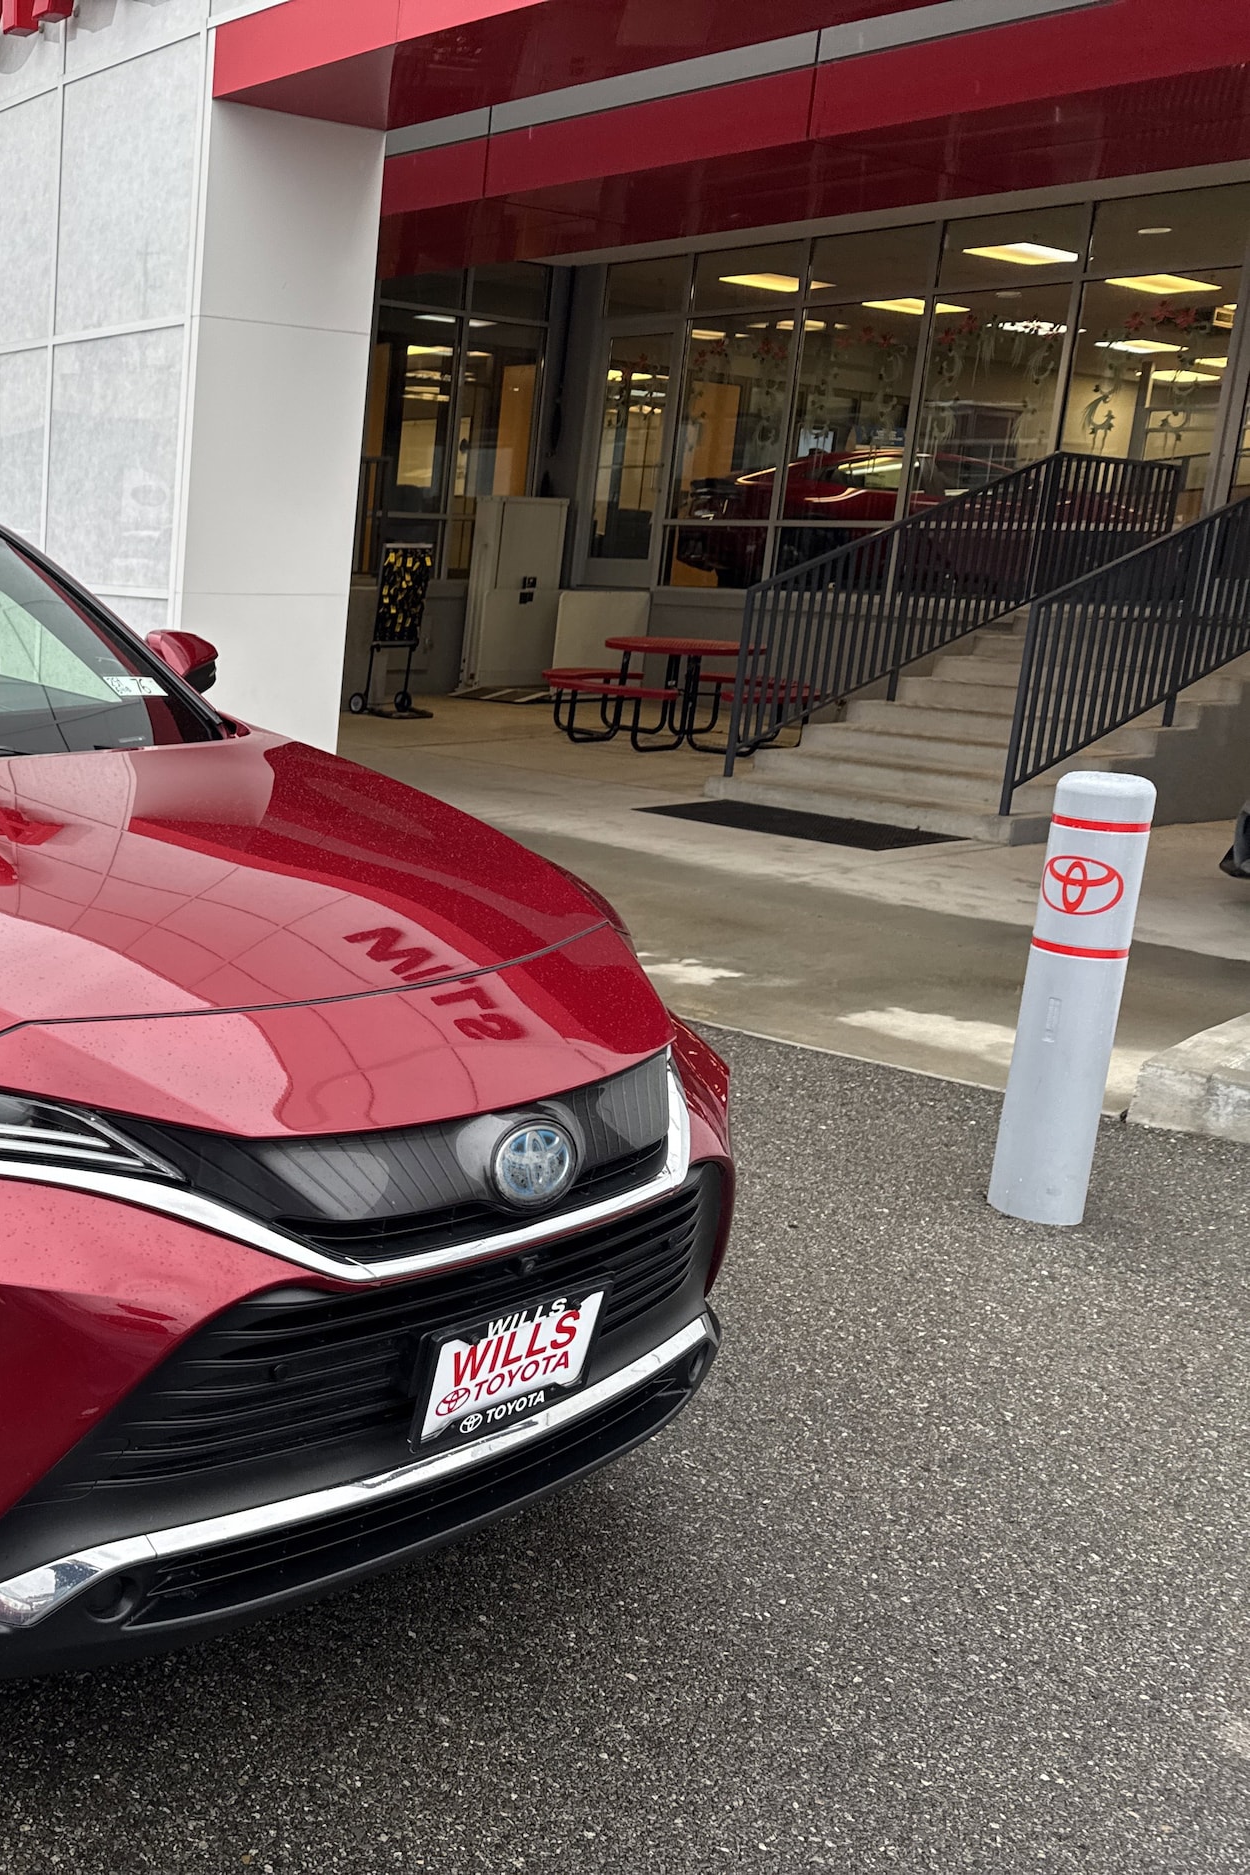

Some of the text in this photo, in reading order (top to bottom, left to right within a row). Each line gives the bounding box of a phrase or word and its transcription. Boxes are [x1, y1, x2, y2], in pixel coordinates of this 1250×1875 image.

[130, 678, 152, 694] 76
[487, 1297, 568, 1338] WILLS
[453, 1309, 581, 1387] WILLS
[474, 1350, 570, 1401] TOYOTA
[486, 1390, 546, 1423] TOYOTA
